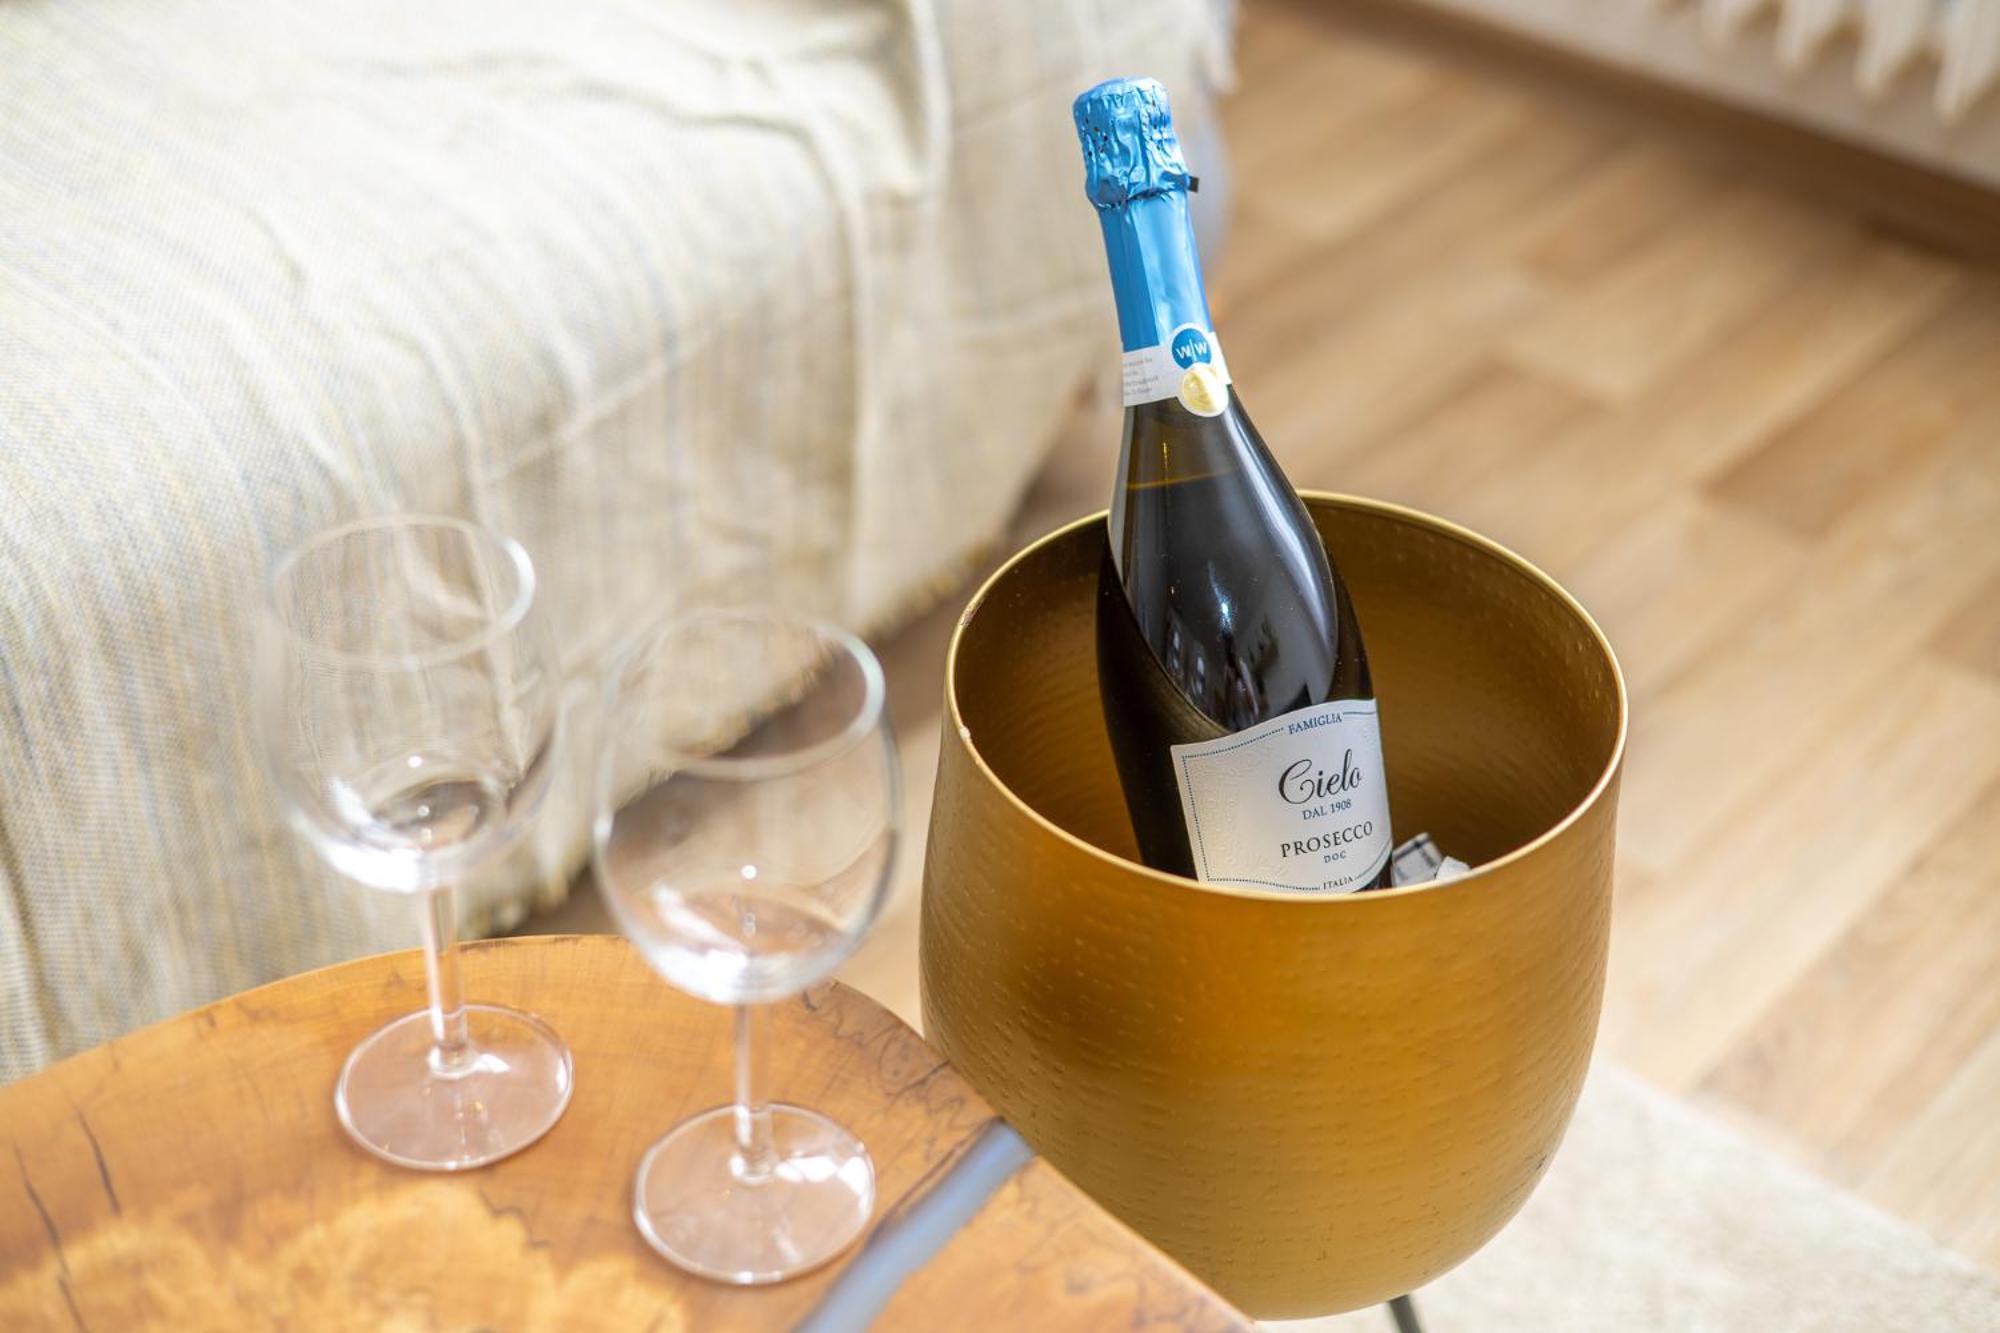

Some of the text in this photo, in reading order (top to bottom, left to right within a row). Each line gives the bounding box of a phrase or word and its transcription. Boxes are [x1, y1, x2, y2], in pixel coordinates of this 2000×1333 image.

[1288, 712, 1342, 735] FAMIGLIA
[1278, 748, 1362, 805] Cielo
[1302, 799, 1352, 820] DAL 1908
[1280, 820, 1373, 858] PROSECCO
[1323, 850, 1347, 863] DOC
[1323, 875, 1353, 890] ITALIA
